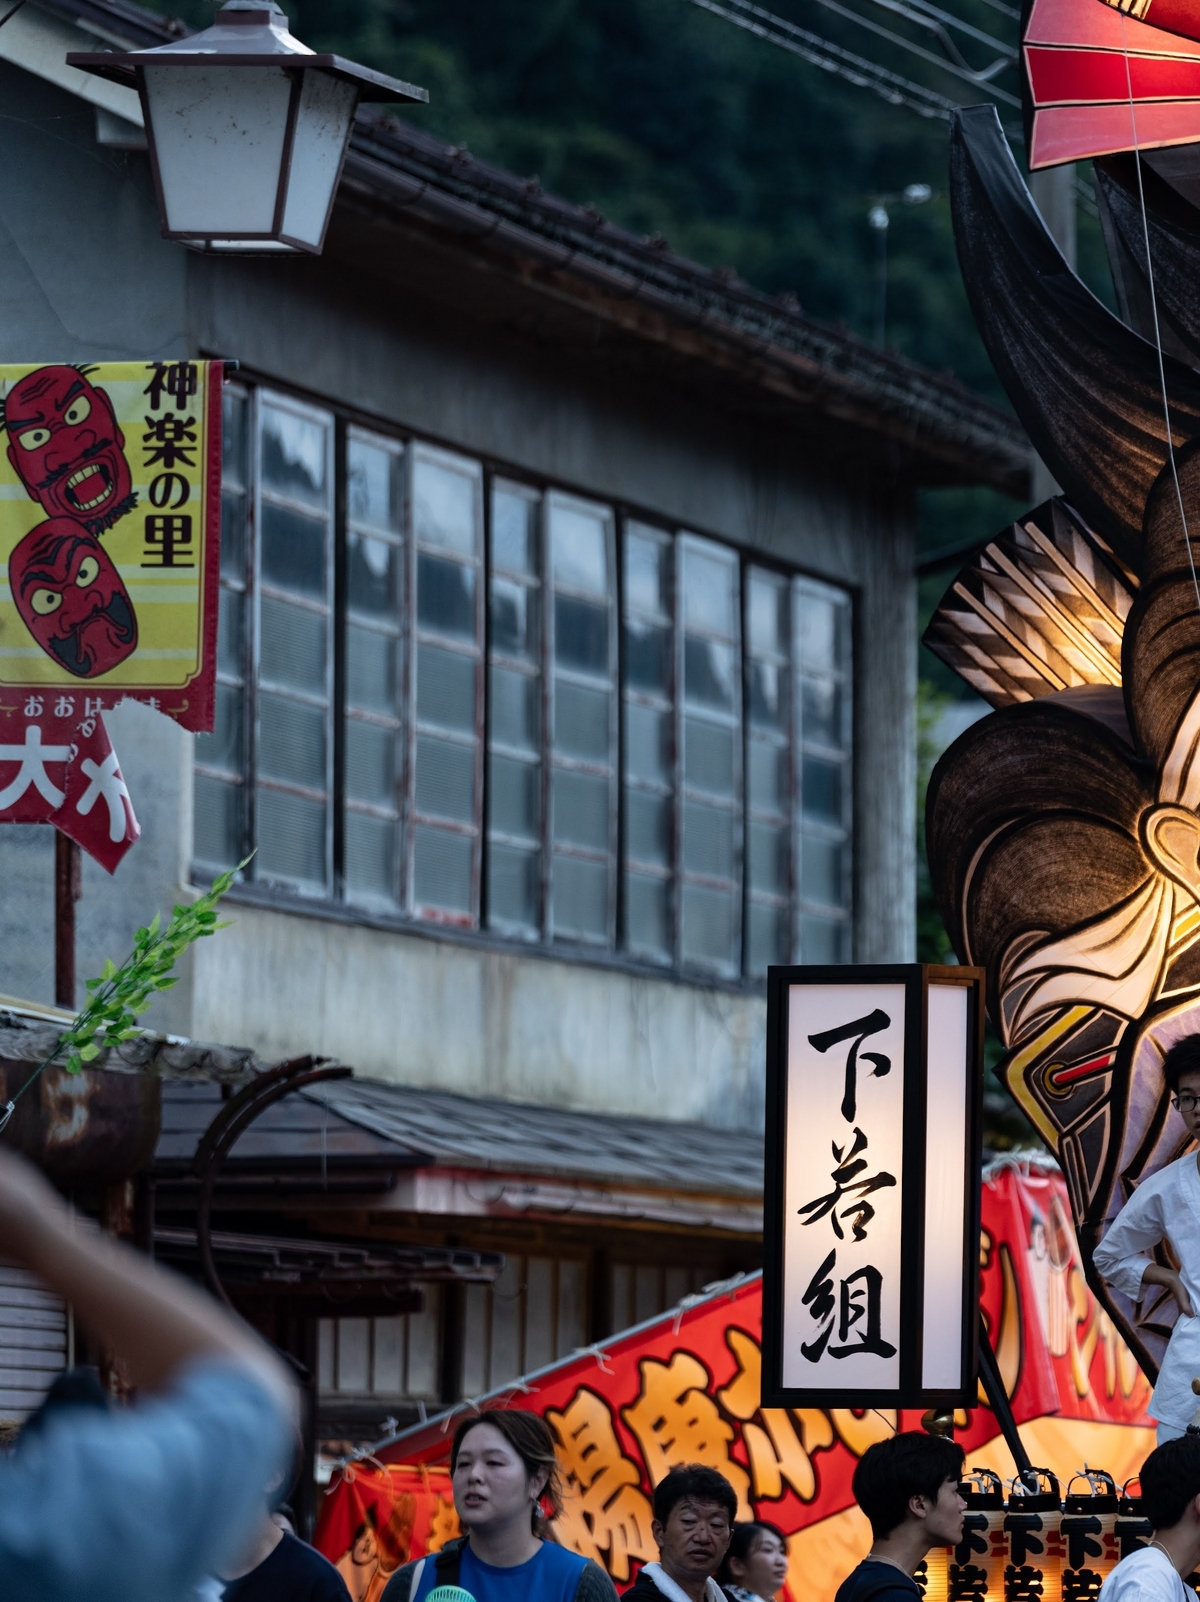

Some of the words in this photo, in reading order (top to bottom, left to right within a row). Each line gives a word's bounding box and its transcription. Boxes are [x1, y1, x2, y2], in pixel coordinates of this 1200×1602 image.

[140, 361, 198, 568] 神楽の里
[24, 696, 161, 718] おおは
[797, 1009, 898, 1364] 下若組
